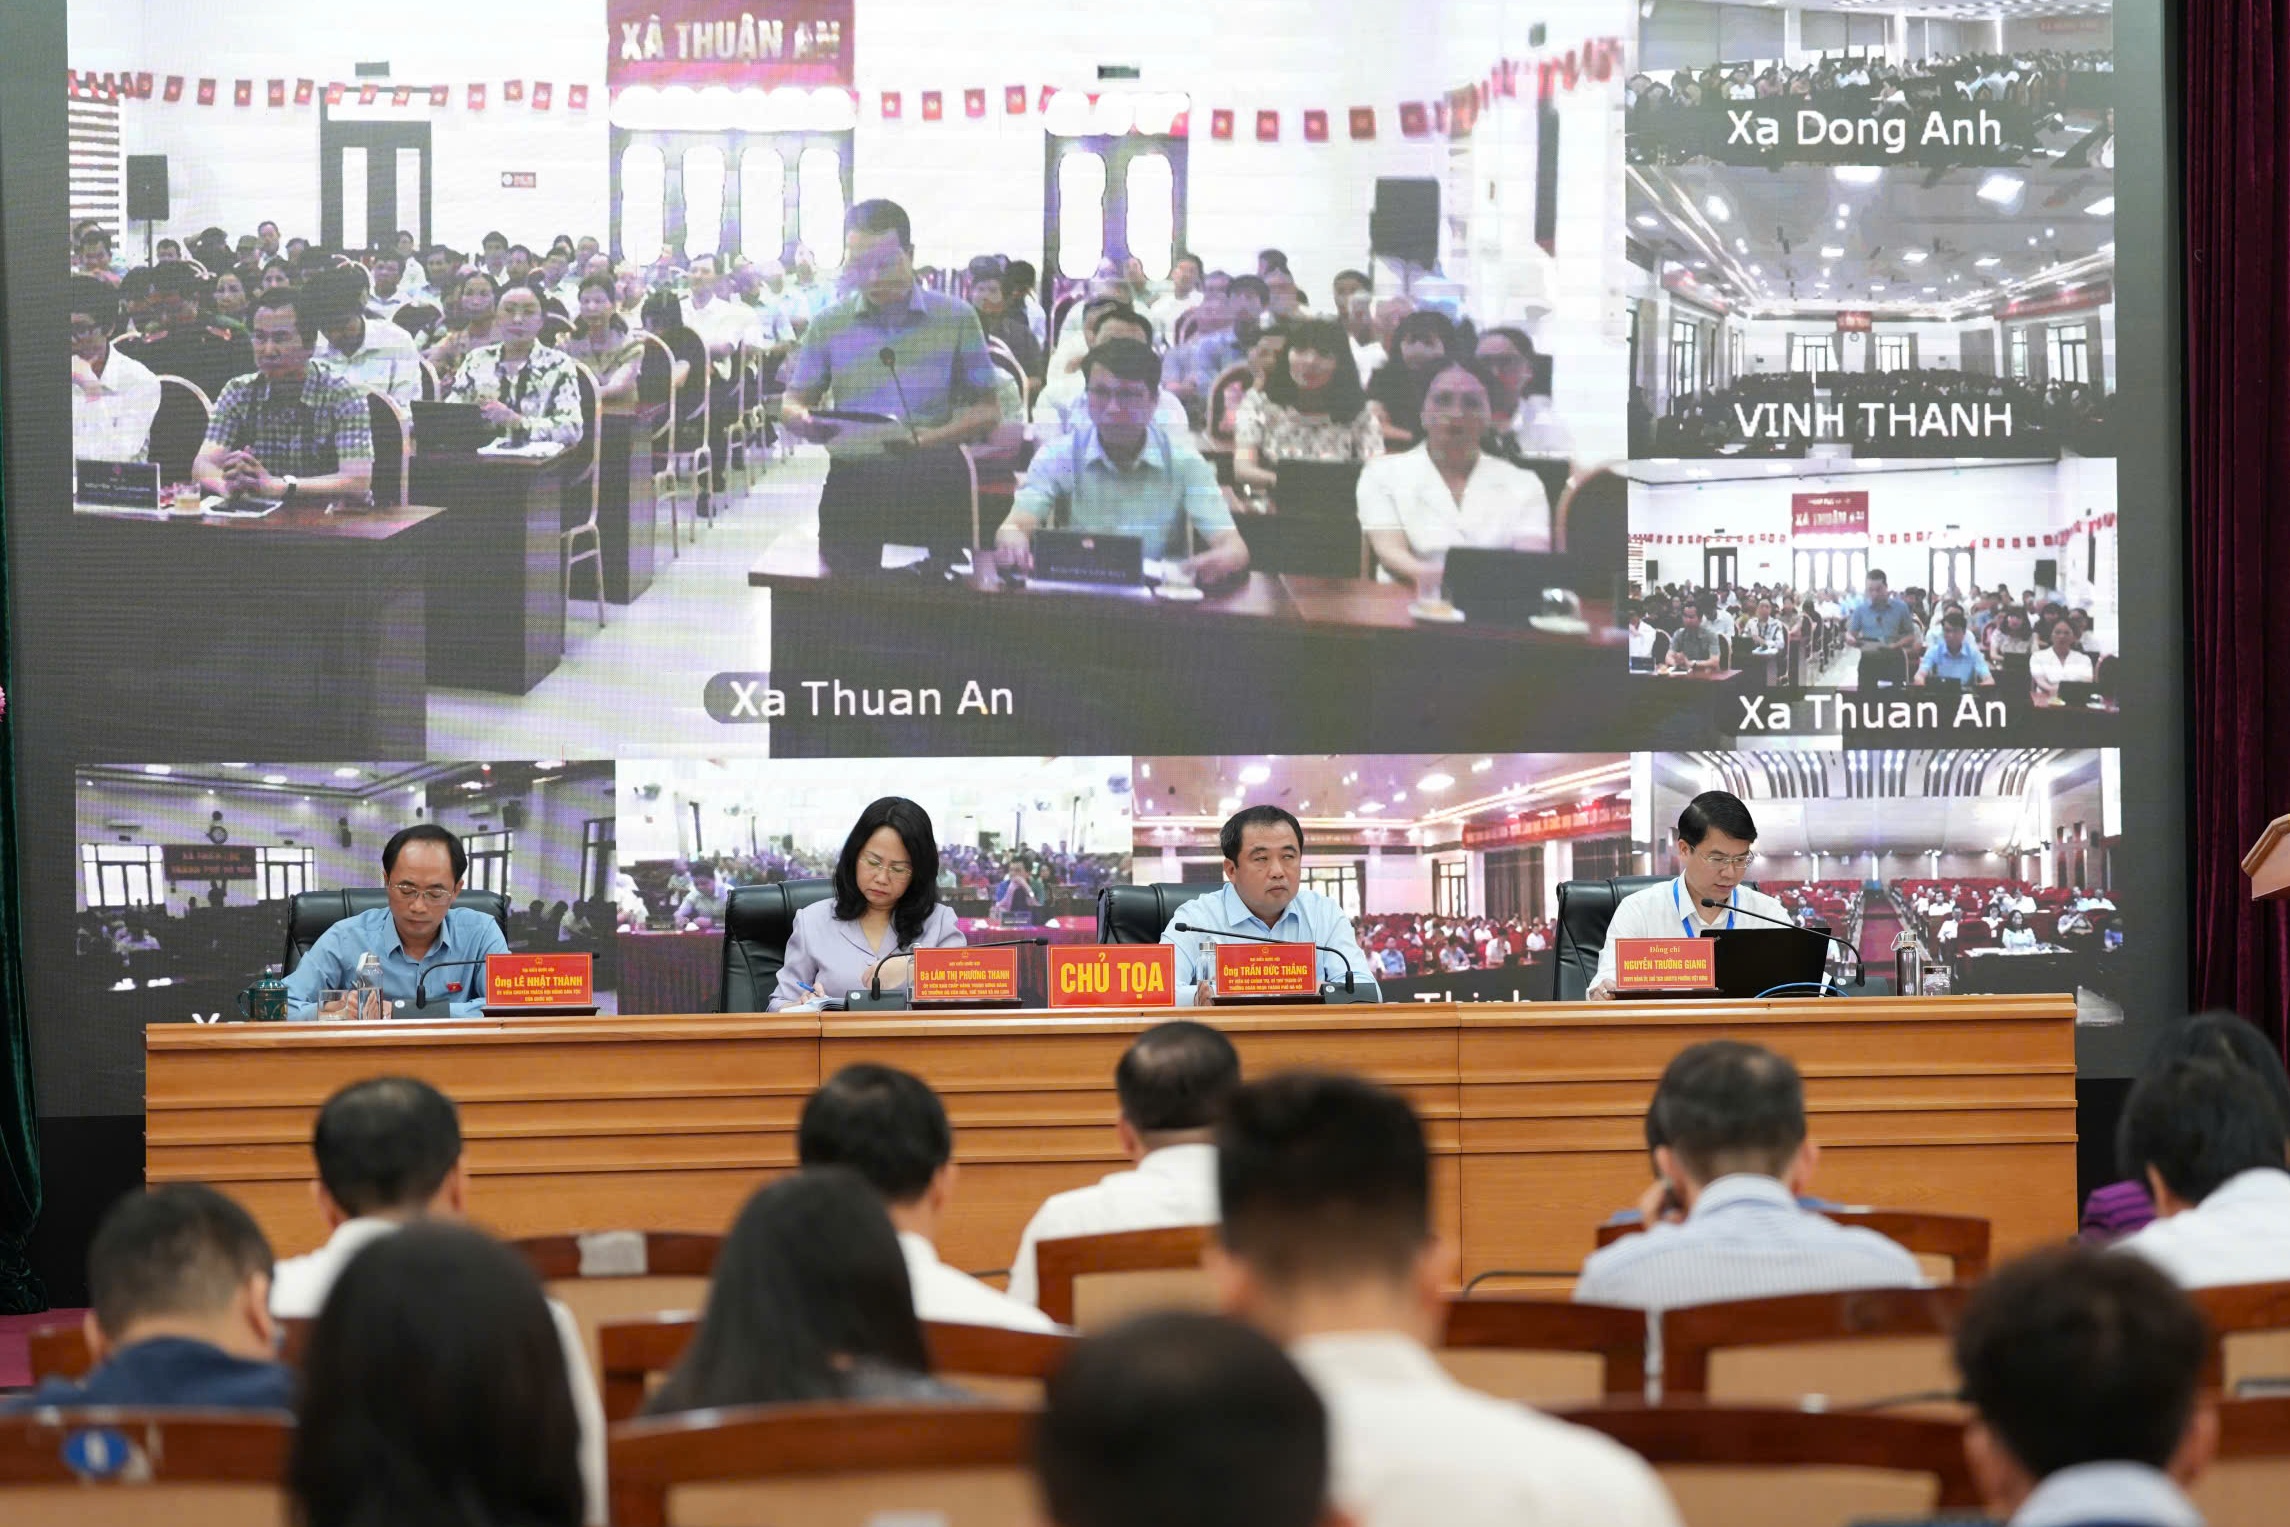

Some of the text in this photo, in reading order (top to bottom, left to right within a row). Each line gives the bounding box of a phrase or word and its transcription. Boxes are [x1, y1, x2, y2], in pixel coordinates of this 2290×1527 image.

[675, 12, 783, 64] THUẬN
[1727, 109, 2001, 153] Xa Dong Anh
[1734, 402, 2012, 438] VINH THANH
[729, 679, 1013, 716] Xa Thuan An
[1738, 693, 2006, 730] Xa Thuan An
[1624, 957, 1706, 970] NGUYỄN TRƯỜNG GIANG
[1650, 945, 1668, 954] Đồng
[495, 974, 582, 988] Ông LÊ NHẬT THÀNH
[931, 969, 945, 980] LÂM
[947, 971, 957, 982] THỊ
[959, 970, 986, 980] PHƯƠNG
[988, 970, 1010, 979] THANH
[1061, 951, 1165, 999] CHỦ TỌA
[1224, 965, 1239, 977] Ông
[1263, 964, 1279, 975] ĐỨC
